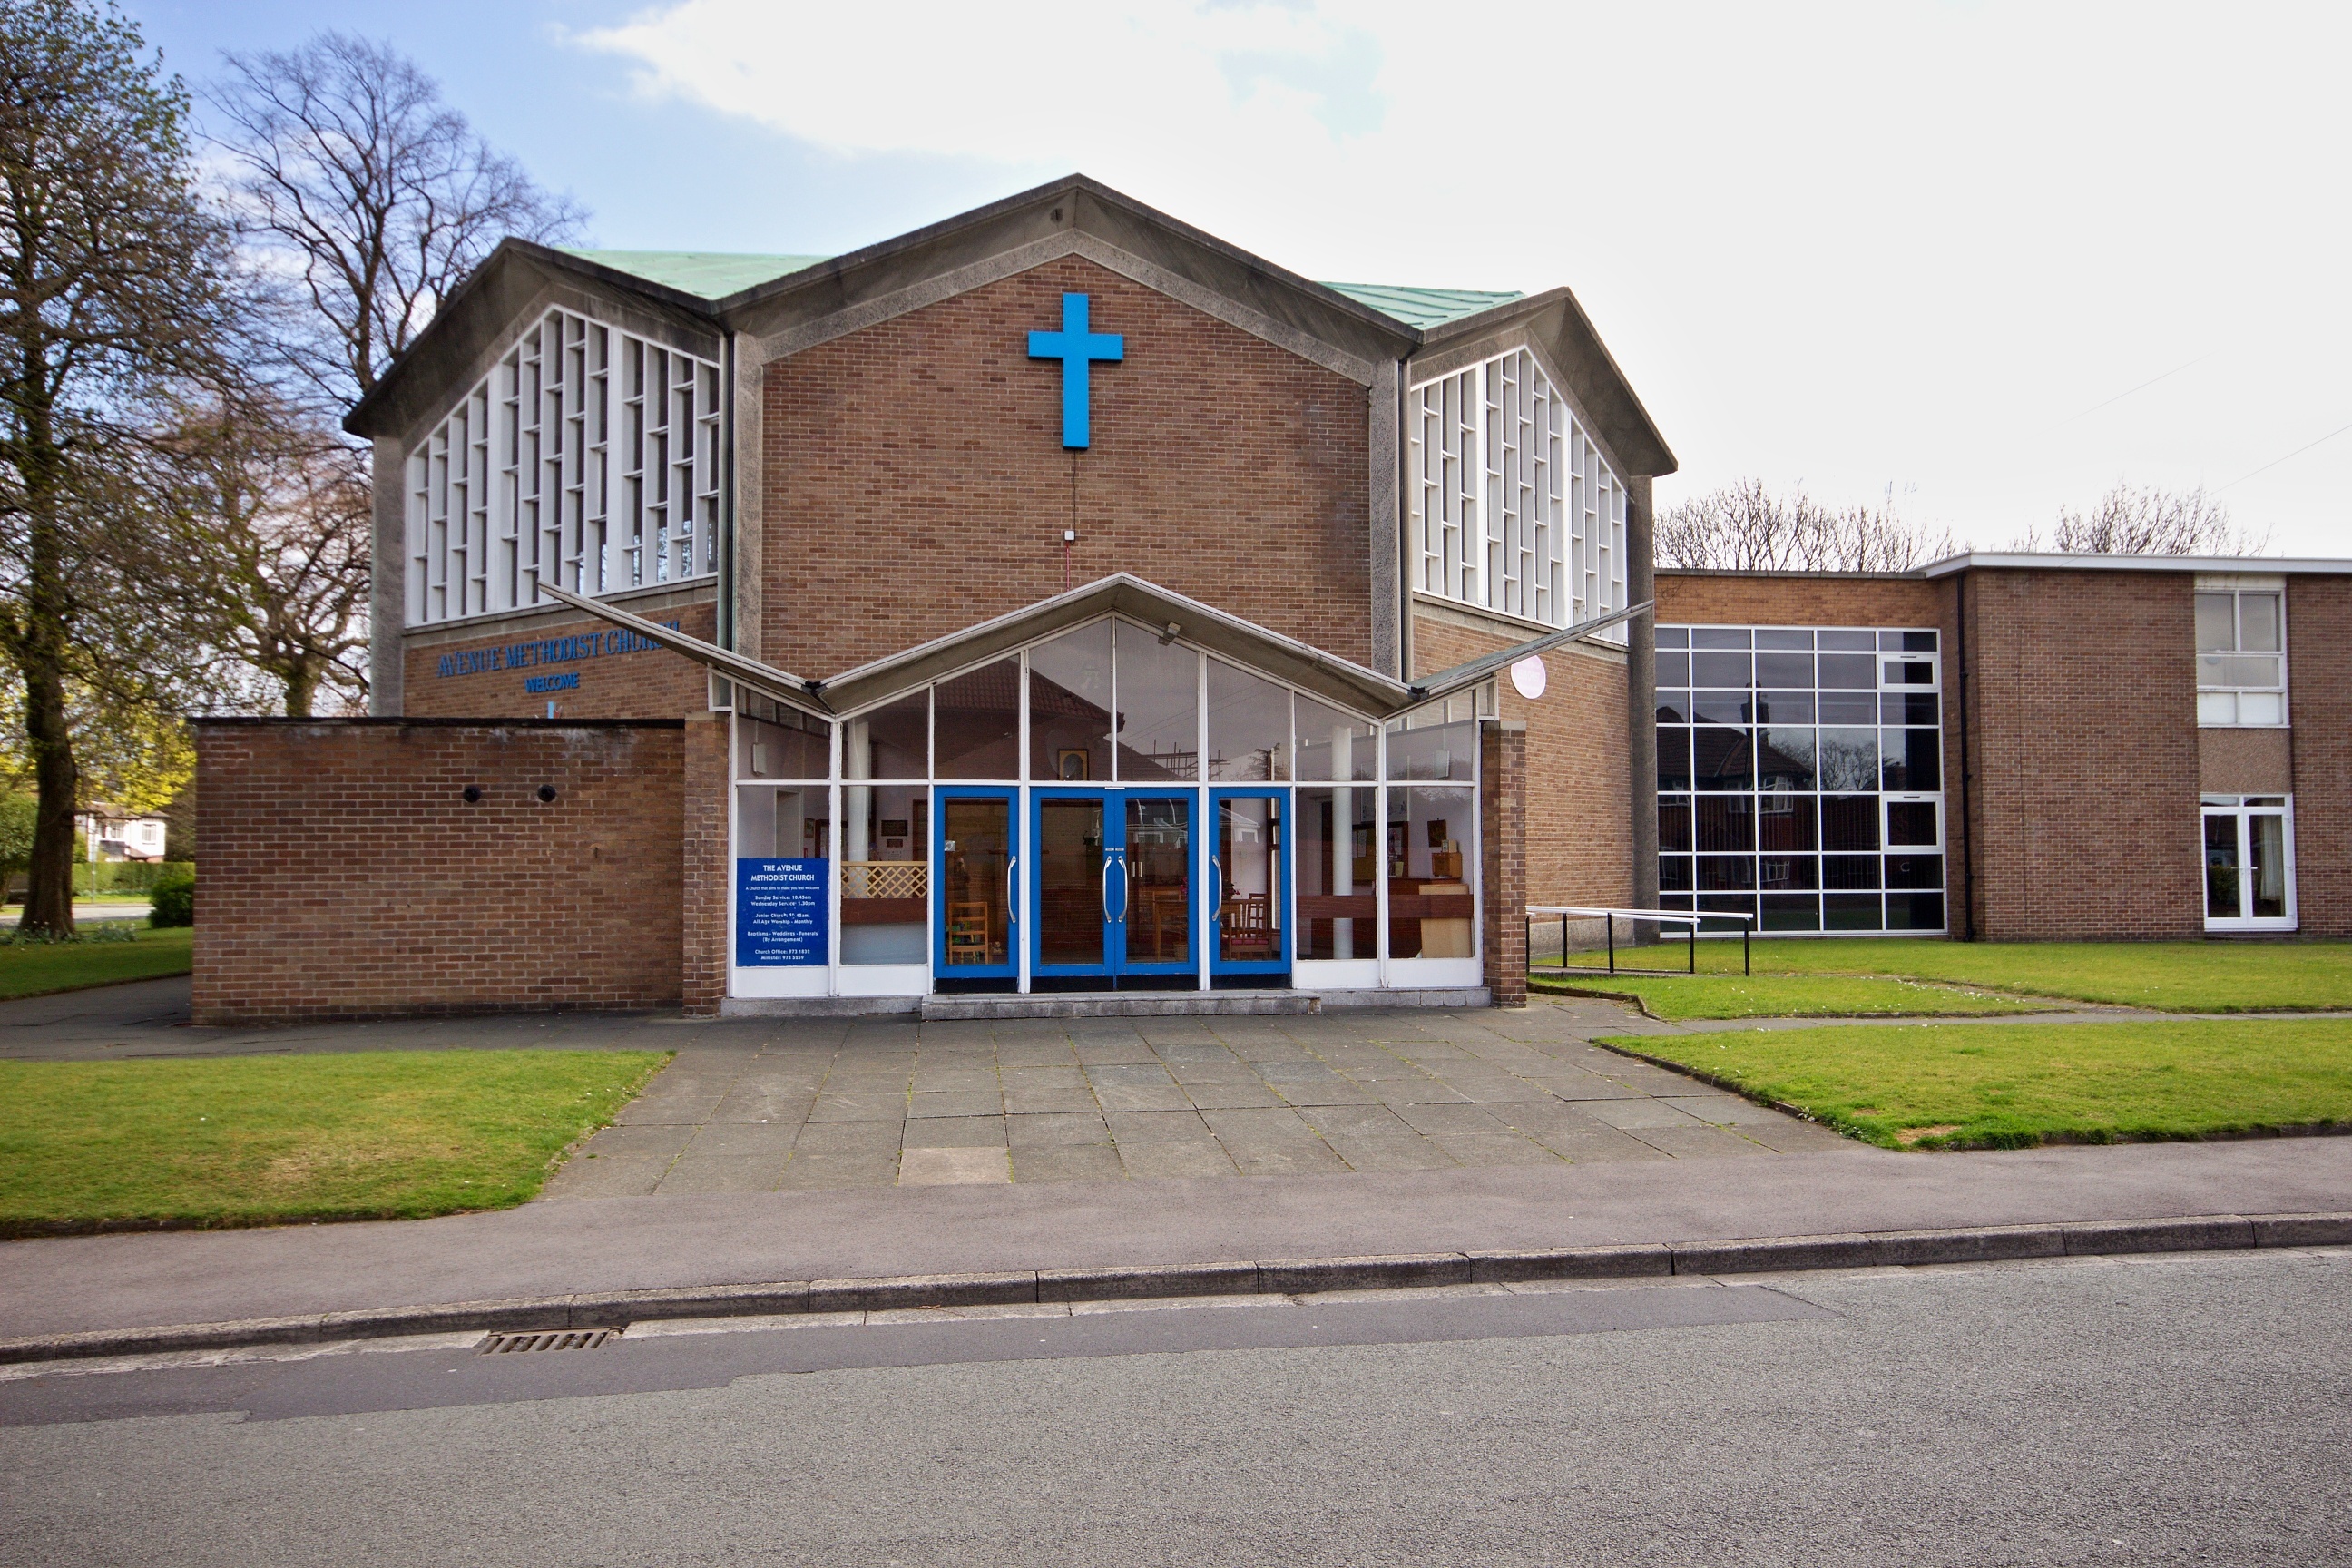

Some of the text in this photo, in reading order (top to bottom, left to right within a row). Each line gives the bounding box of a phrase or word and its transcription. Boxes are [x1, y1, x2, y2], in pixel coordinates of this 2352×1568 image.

[436, 621, 680, 679] AVENUE METHODIST CHU
[524, 671, 581, 693] WELCOME
